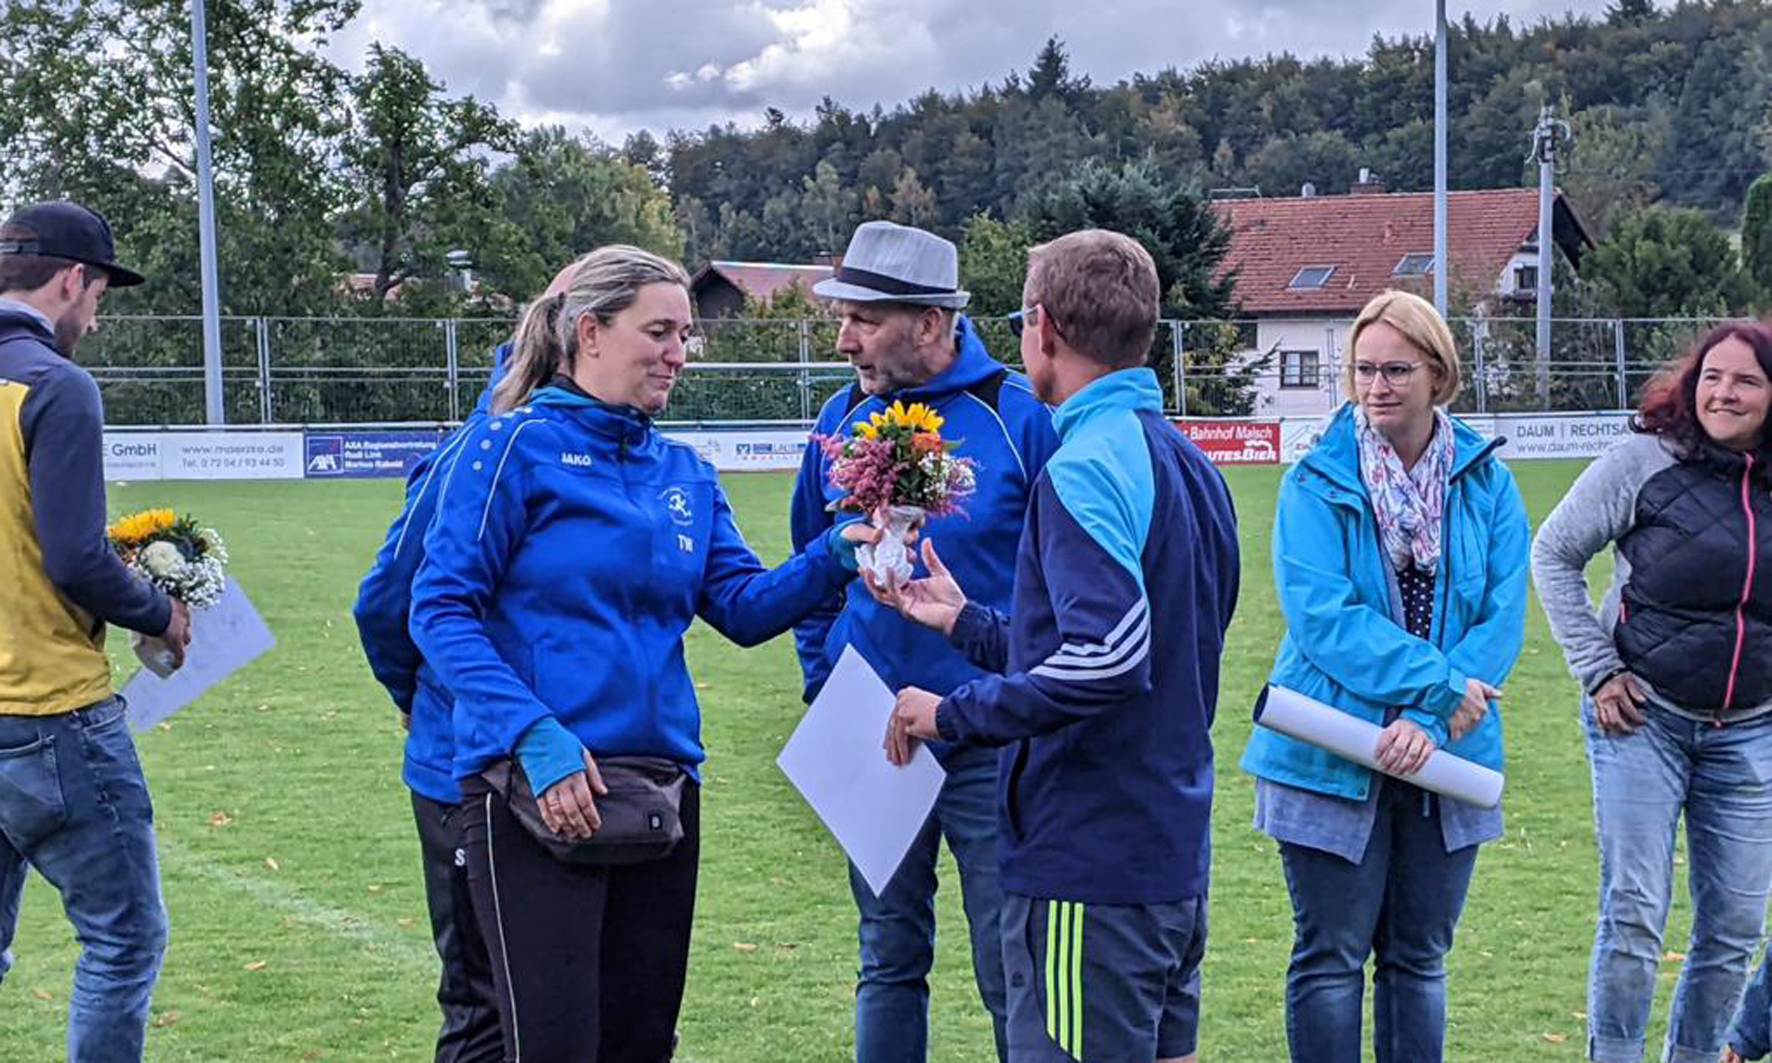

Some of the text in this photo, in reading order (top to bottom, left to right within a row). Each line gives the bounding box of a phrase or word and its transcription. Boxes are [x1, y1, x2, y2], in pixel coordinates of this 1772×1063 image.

[1190, 426, 1234, 440] Bahnhof
[1236, 426, 1273, 439] Malsch
[1516, 425, 1554, 438] DAUM
[112, 443, 157, 456] GmbH
